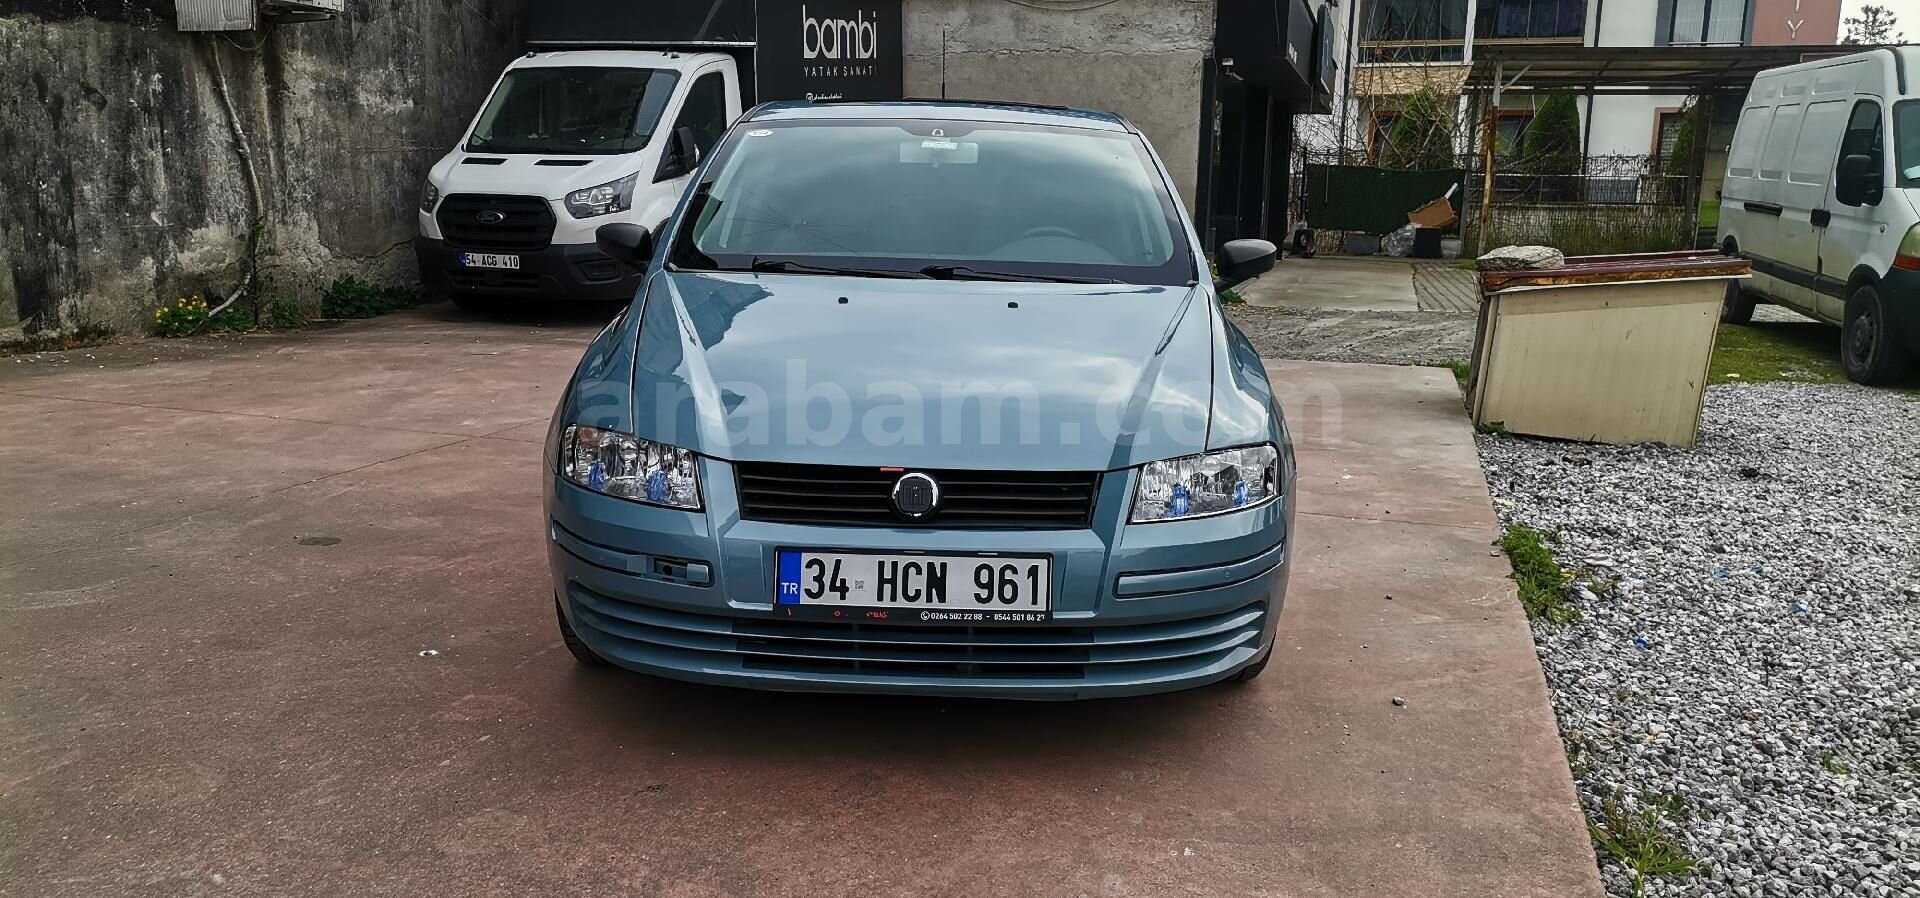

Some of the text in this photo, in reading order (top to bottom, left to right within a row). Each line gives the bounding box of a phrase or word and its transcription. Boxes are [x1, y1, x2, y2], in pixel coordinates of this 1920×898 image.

[803, 4, 877, 59] bambi
[804, 66, 838, 77] YATAK
[466, 254, 476, 265] 54
[503, 256, 519, 267] 410
[803, 557, 1040, 606] 34 HCN 961
[781, 582, 799, 595] TR
